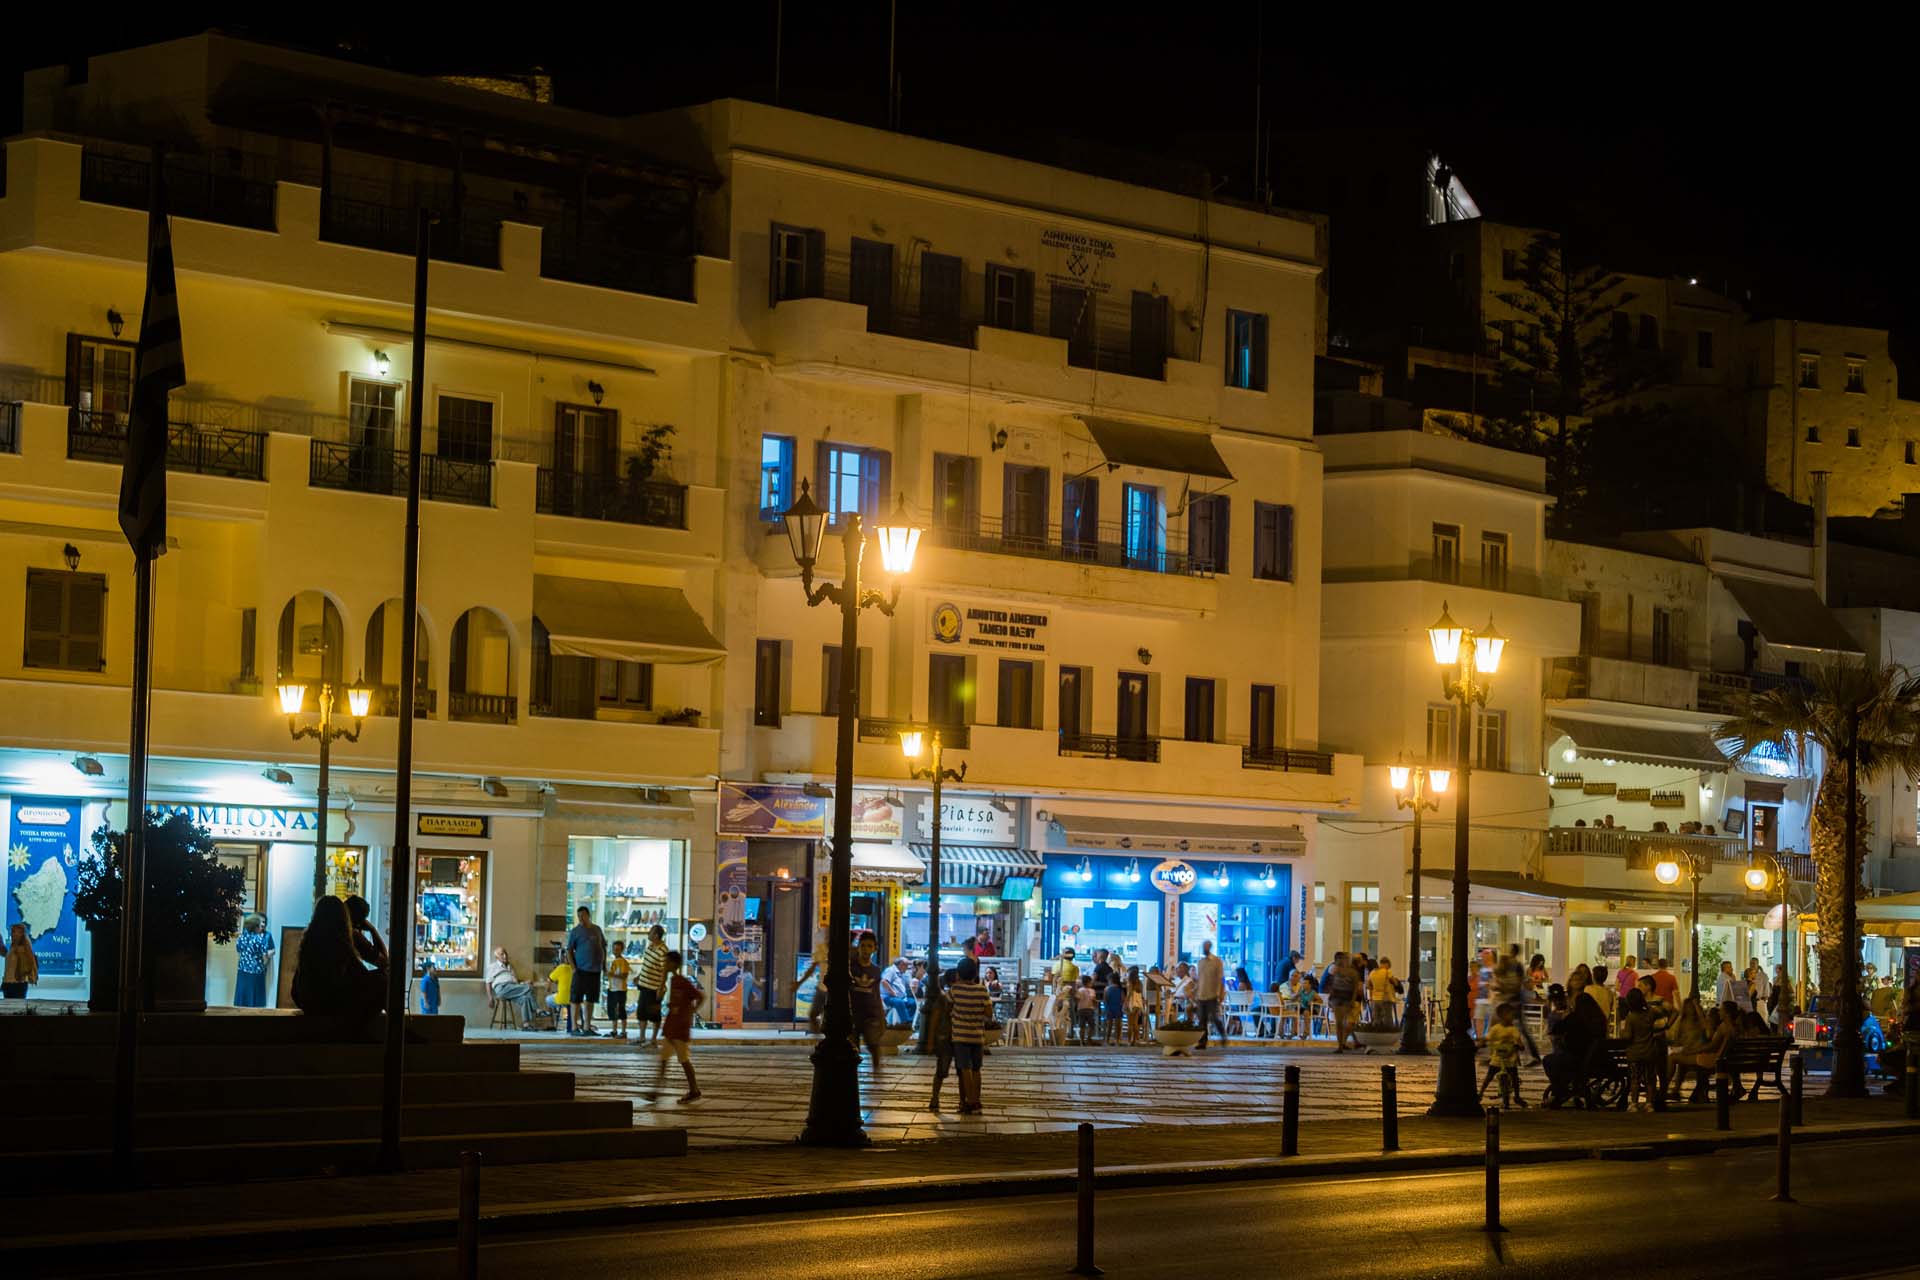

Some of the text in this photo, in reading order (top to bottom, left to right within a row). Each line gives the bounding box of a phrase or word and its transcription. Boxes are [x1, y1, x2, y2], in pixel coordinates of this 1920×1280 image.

[967, 608, 1048, 627] ΔΗΜΟΤΙΚΟ ΛΙΜΕΝΙΚΟ
[978, 622, 1036, 639] ΤΑΜΕΙΟ ΝΑΞΟΥ
[995, 640, 1008, 648] PORT
